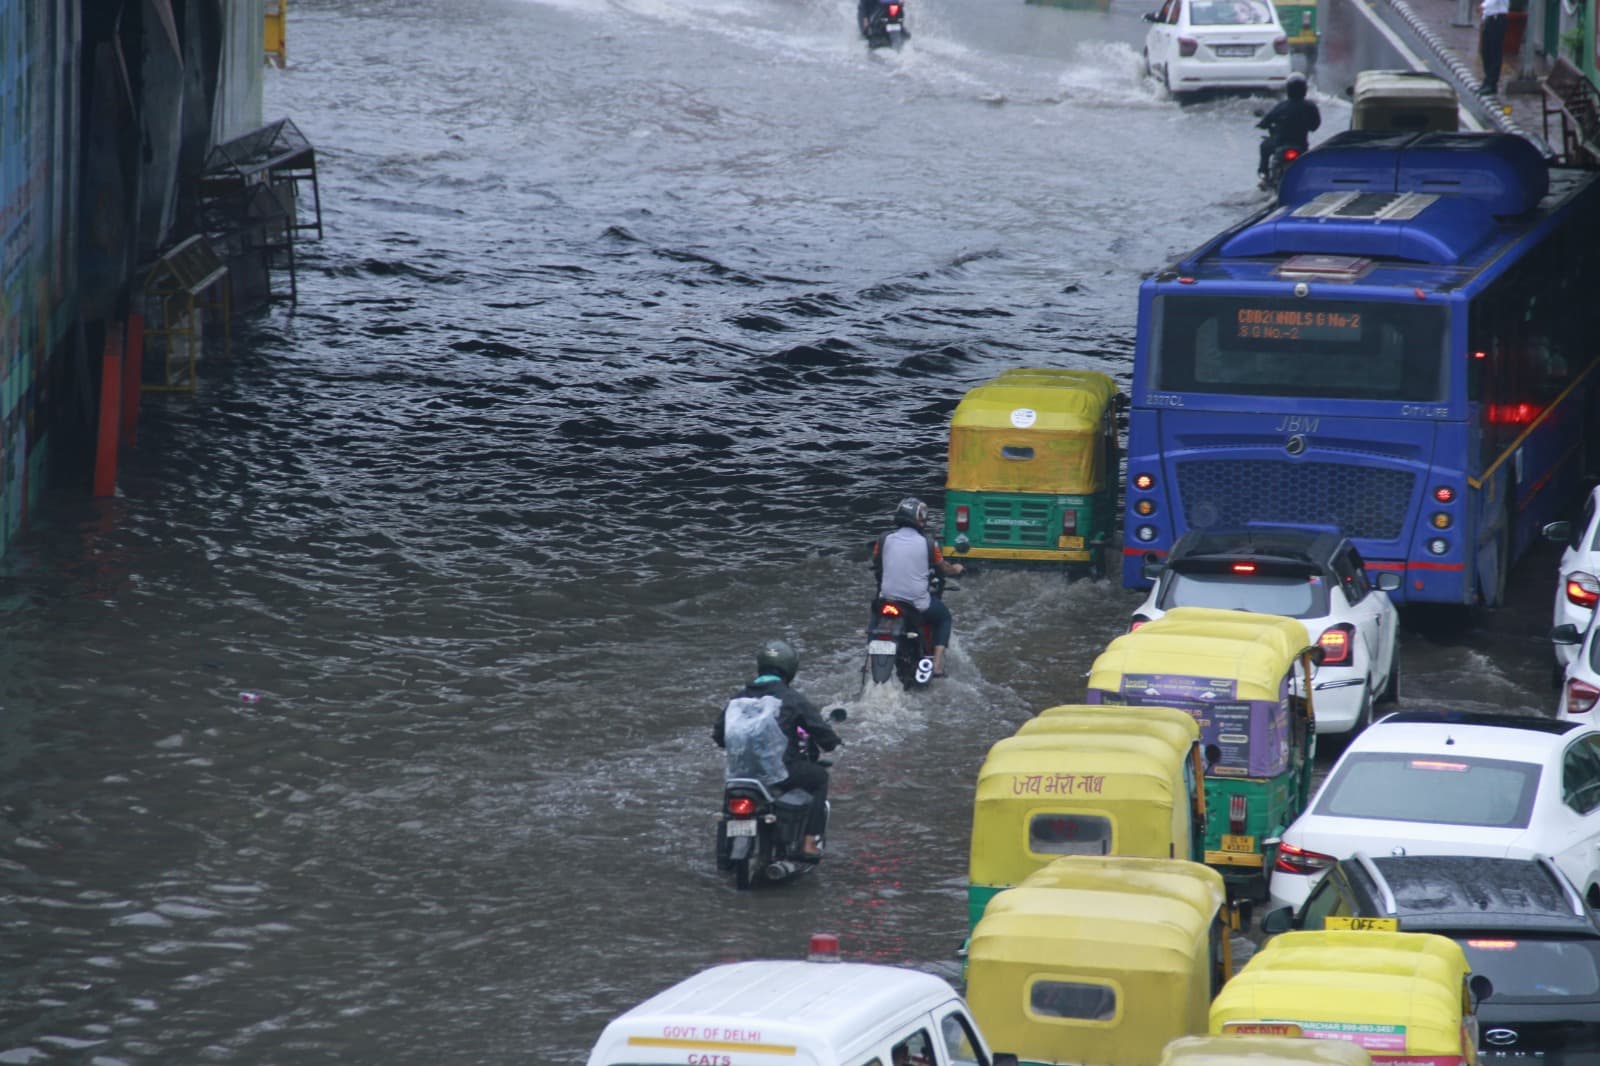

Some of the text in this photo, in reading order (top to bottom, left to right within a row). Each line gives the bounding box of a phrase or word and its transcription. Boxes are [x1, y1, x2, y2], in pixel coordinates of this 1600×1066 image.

[1275, 416, 1320, 433] JBM
[703, 1027, 719, 1039] OF
[723, 1029, 761, 1041] DELHI
[687, 1053, 732, 1066] CATS
